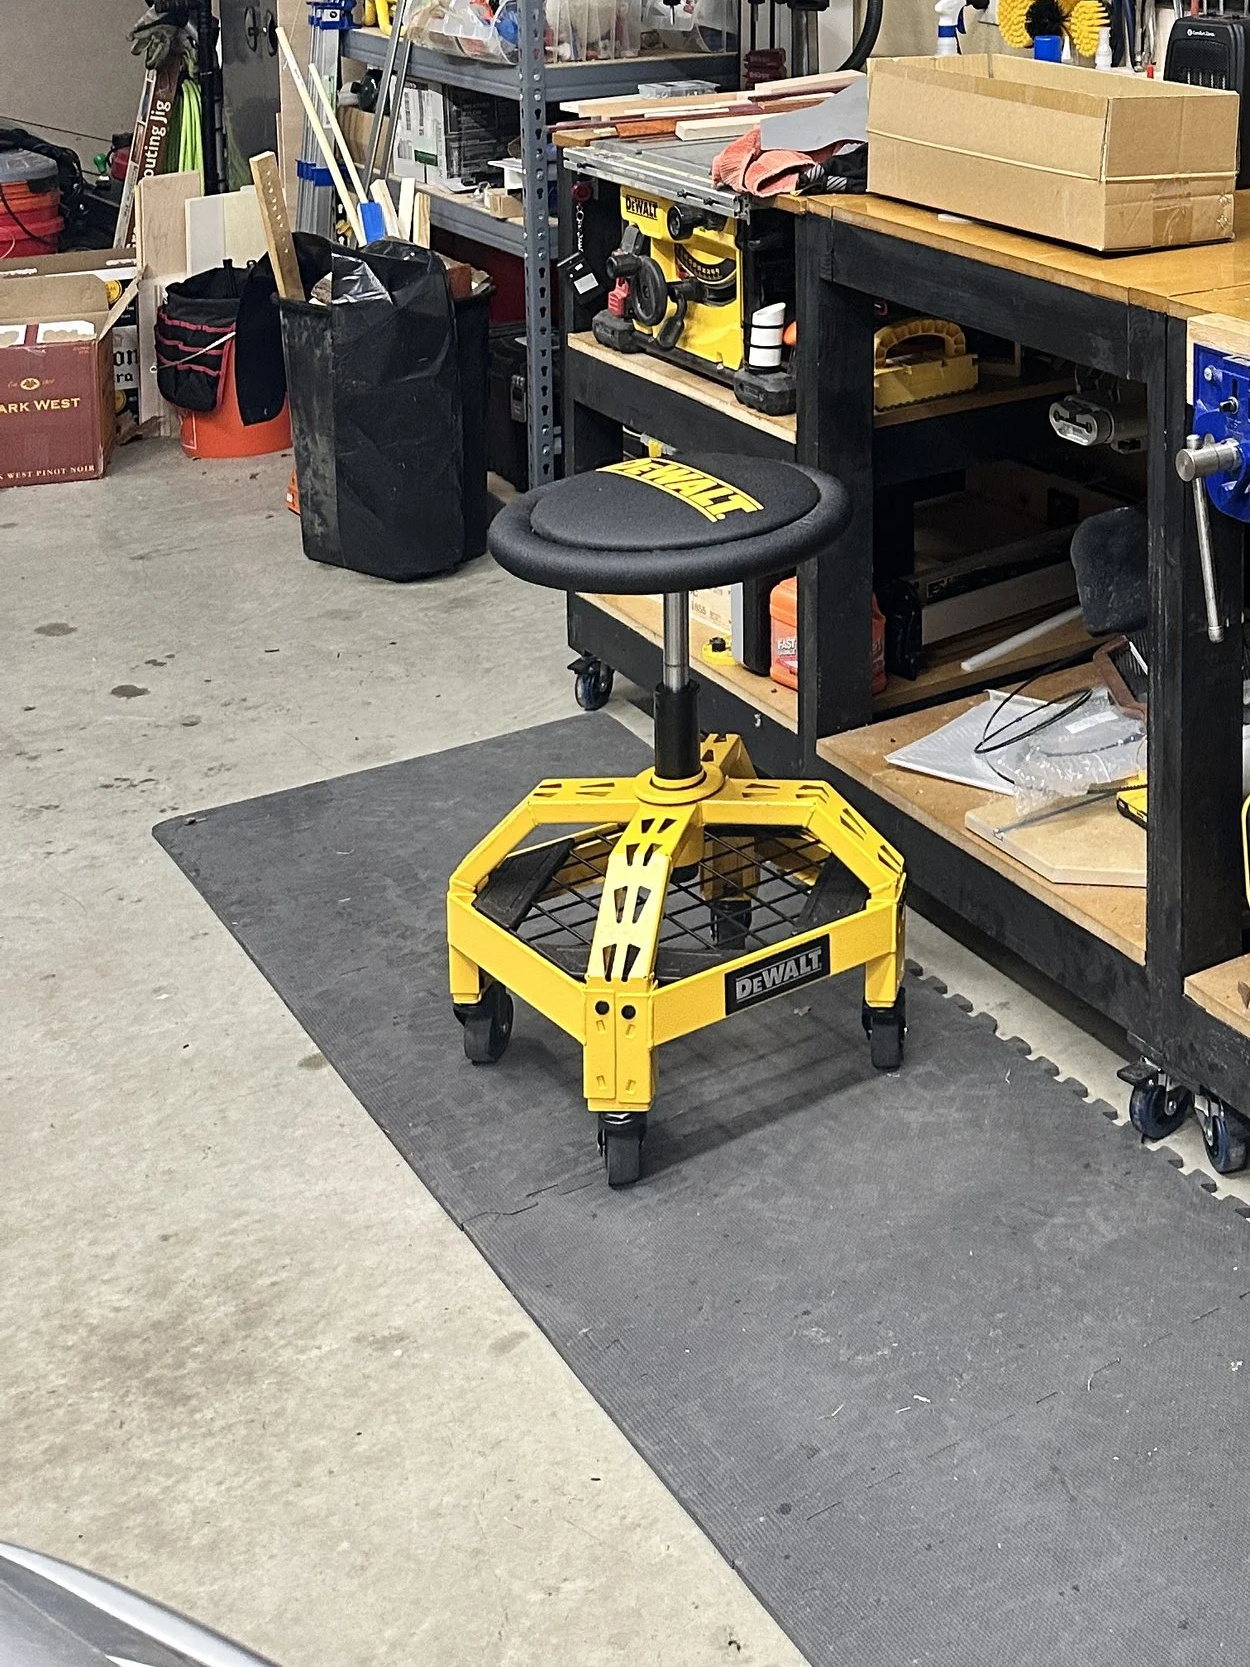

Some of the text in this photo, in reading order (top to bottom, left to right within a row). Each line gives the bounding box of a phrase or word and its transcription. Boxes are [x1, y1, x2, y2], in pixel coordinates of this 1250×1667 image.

[144, 100, 171, 179] outing Jig
[625, 195, 658, 220] DEWALT
[33, 398, 81, 411] WEST
[7, 470, 33, 479] WEST
[36, 467, 66, 477] PINOT
[70, 464, 95, 474] NOIR
[736, 949, 822, 1000] DEWALT
